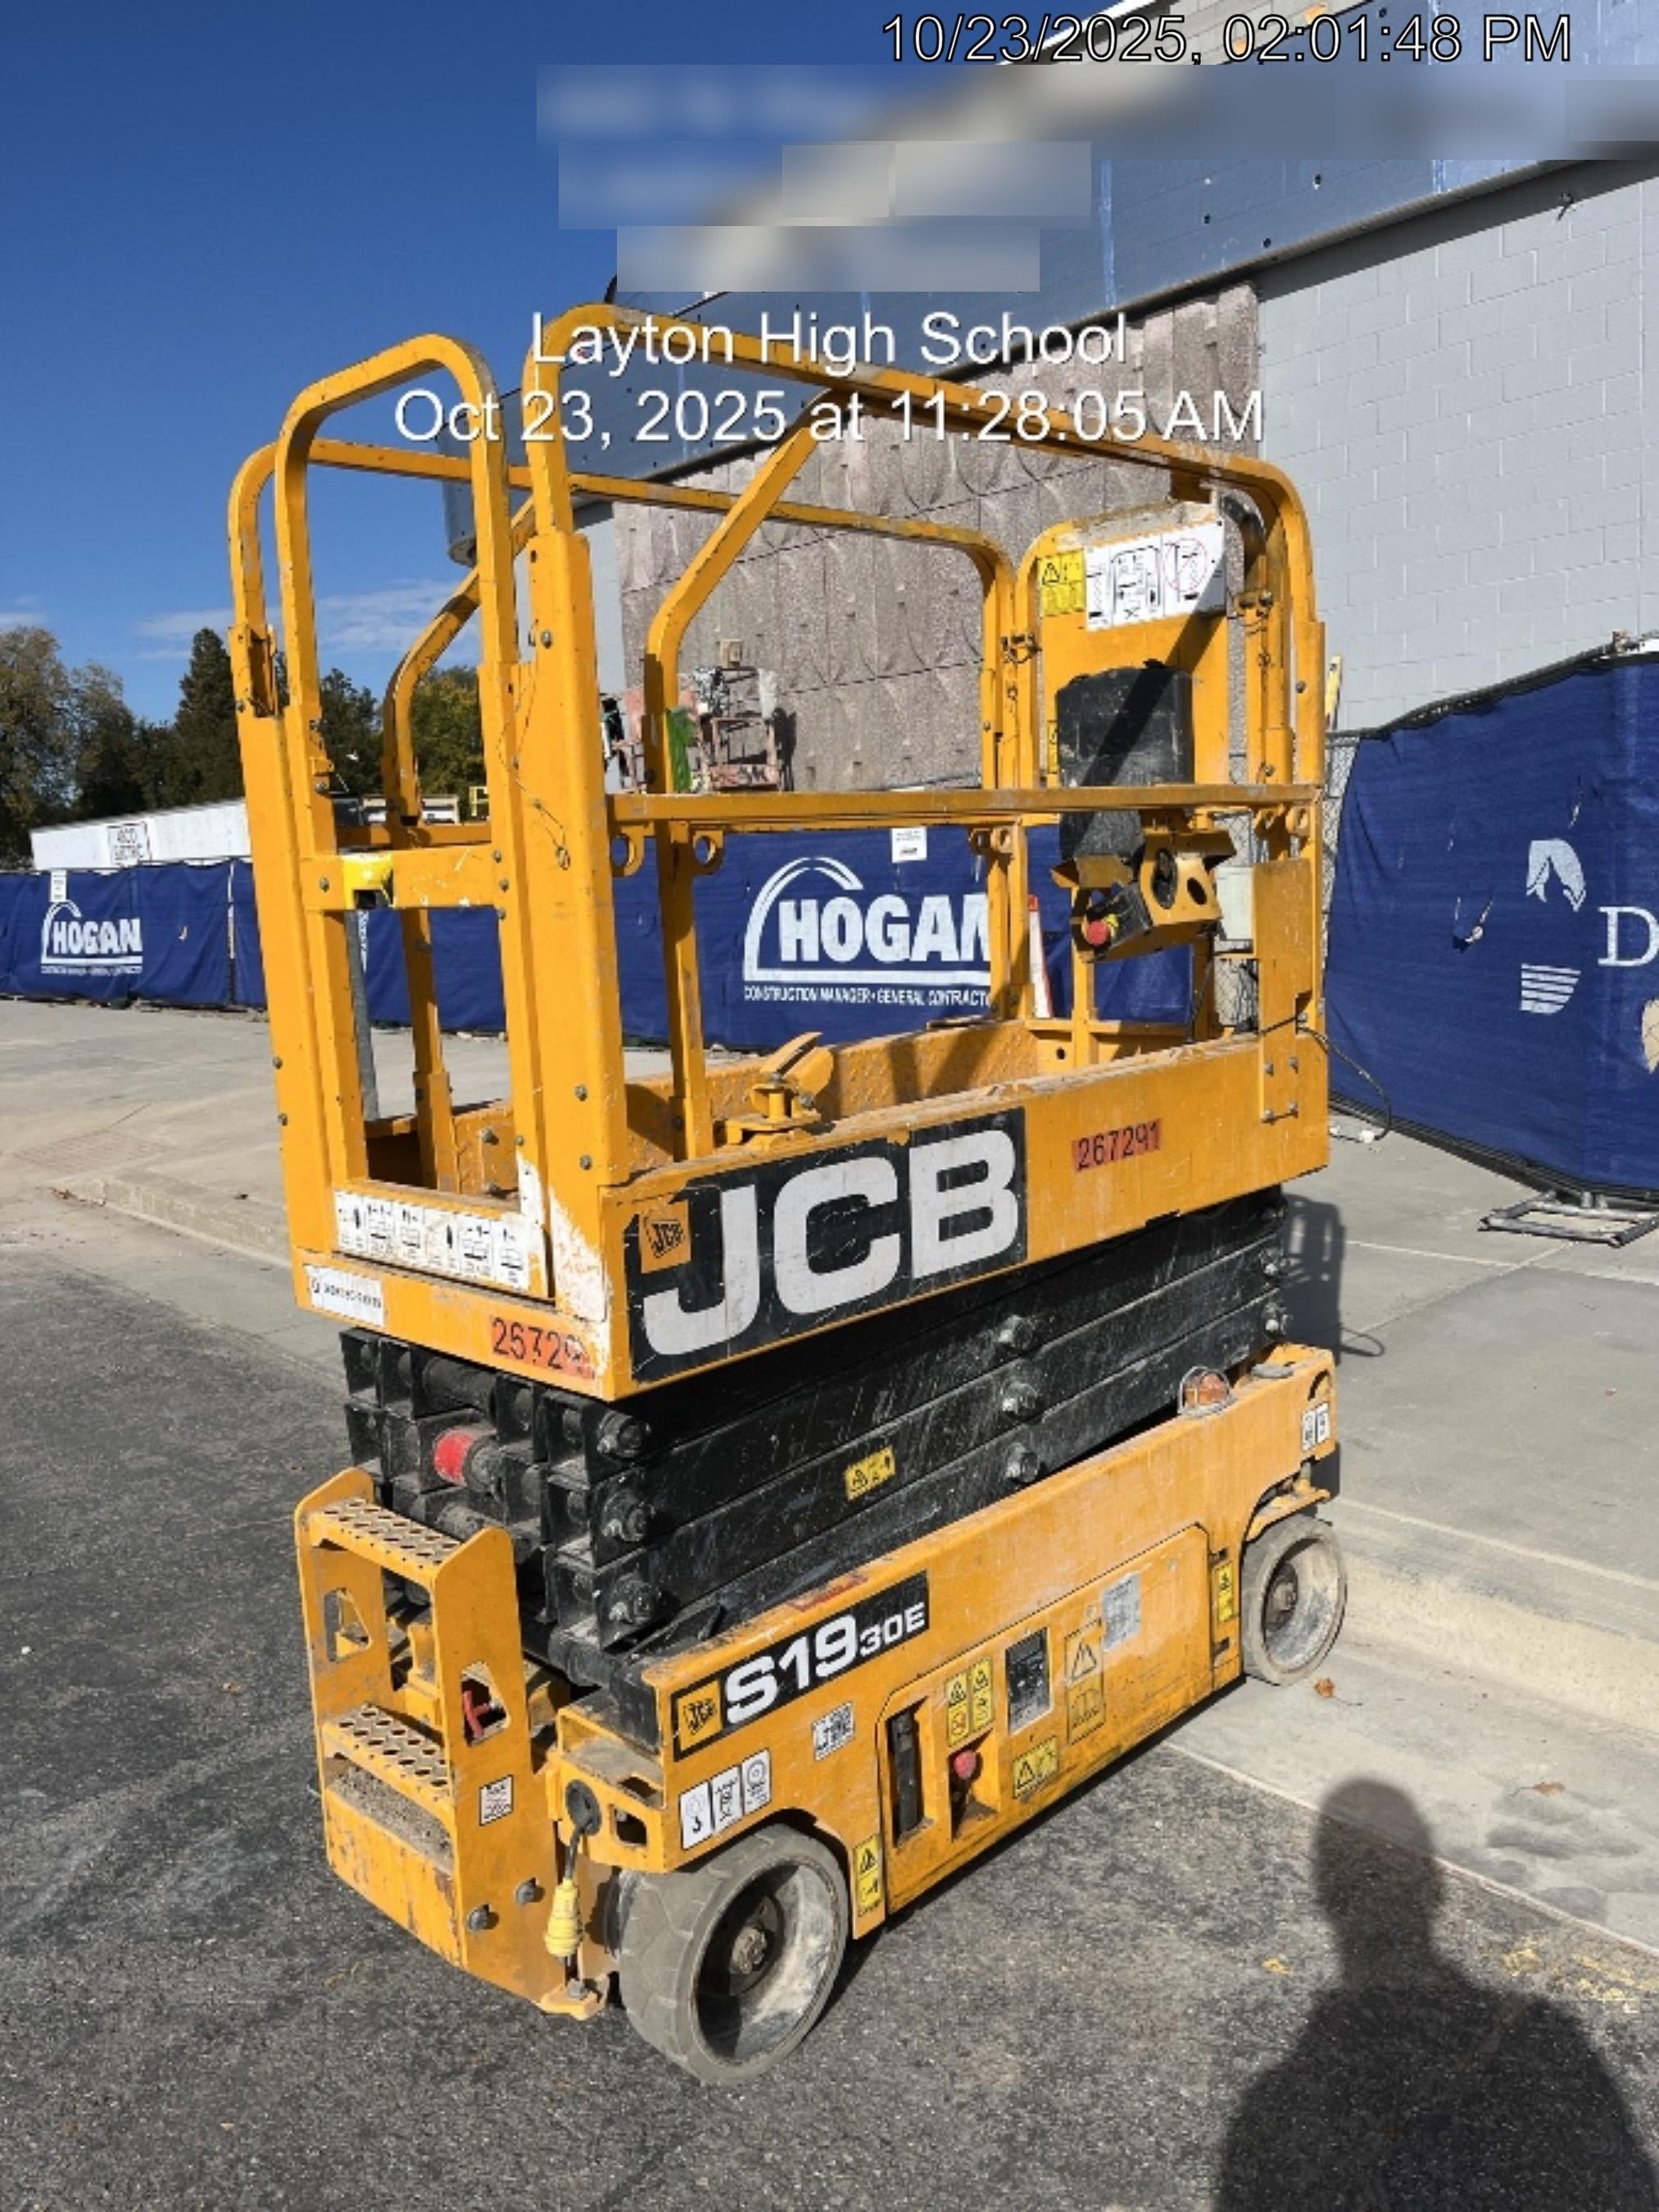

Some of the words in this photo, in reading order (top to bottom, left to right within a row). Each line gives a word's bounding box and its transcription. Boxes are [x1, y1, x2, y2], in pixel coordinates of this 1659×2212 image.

[52, 918, 143, 955] HOGAN
[744, 986, 818, 1001] CONSTRUCTION
[877, 988, 925, 1006] GENERAL
[1077, 1122, 1158, 1172] 267291
[643, 1129, 1018, 1356] JCB
